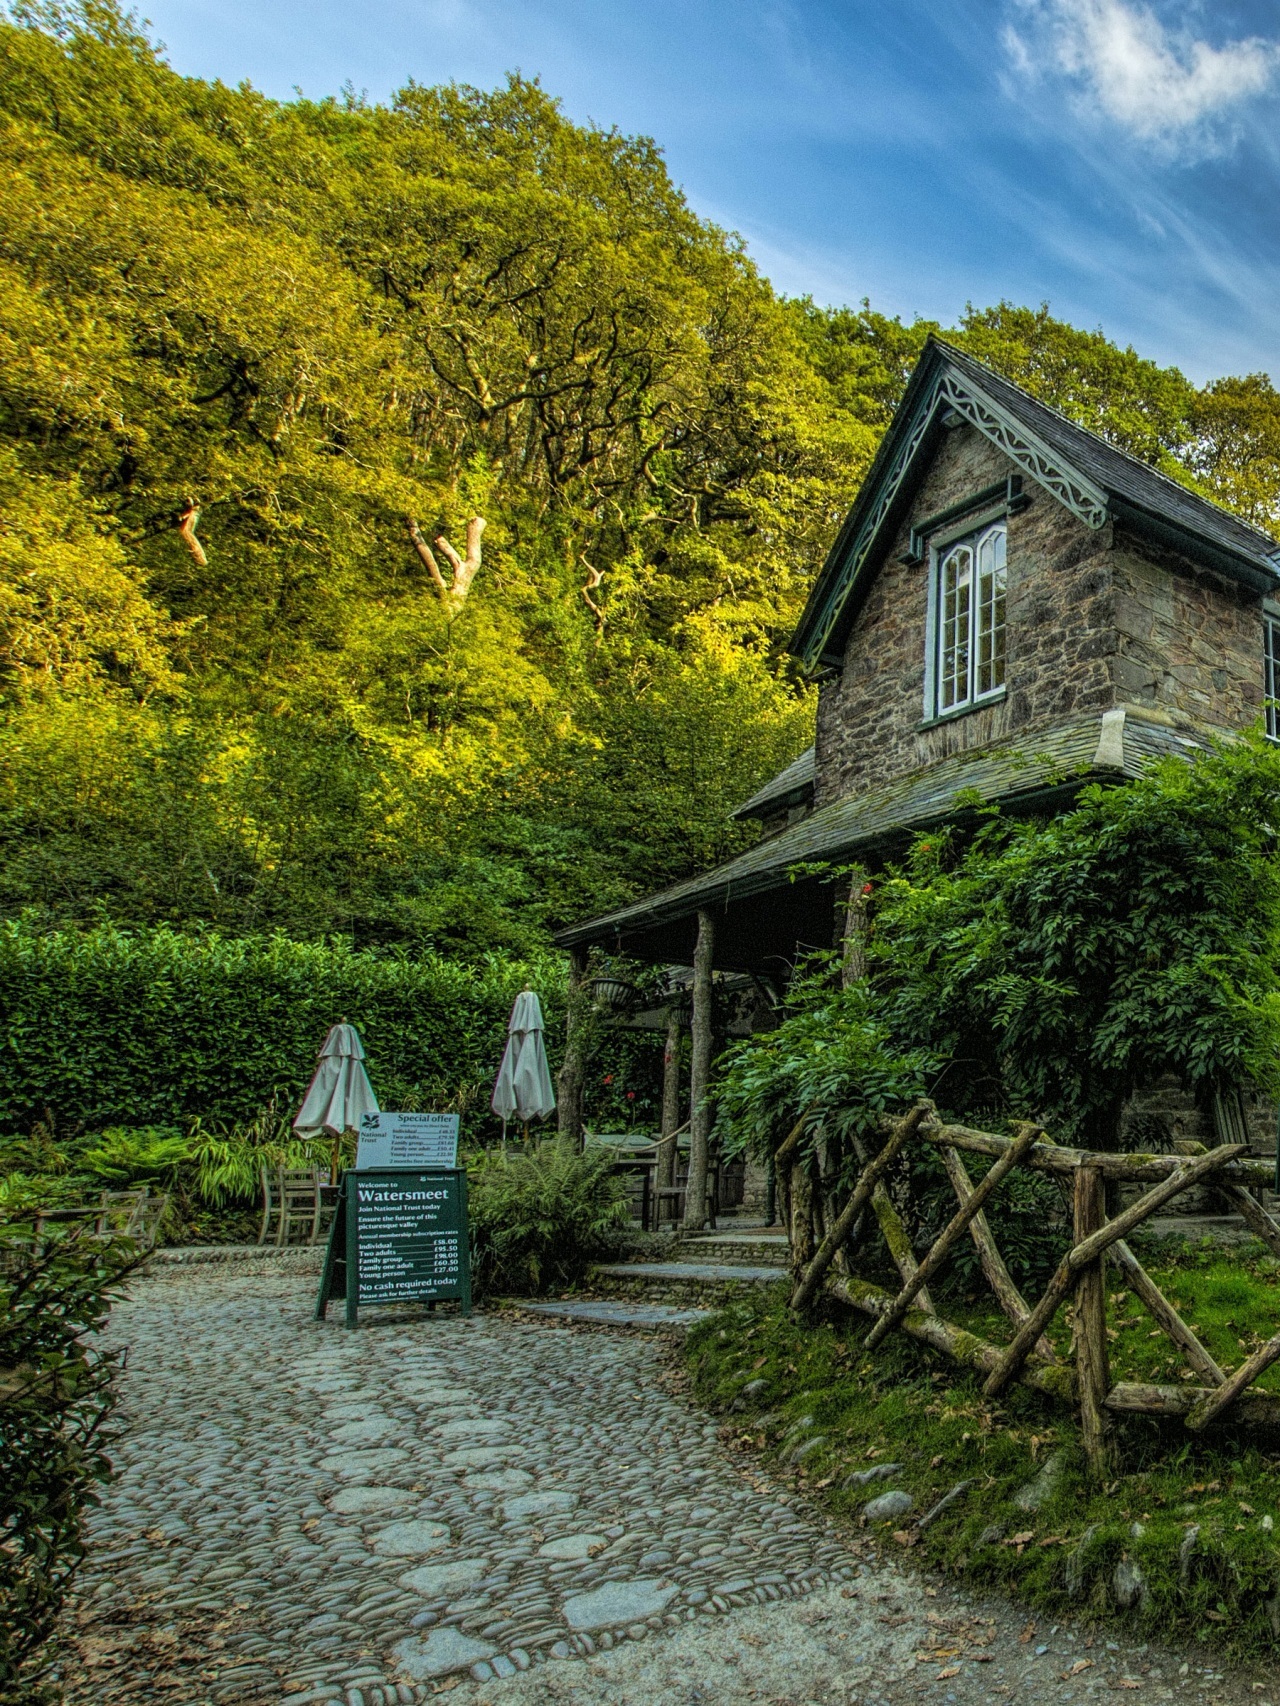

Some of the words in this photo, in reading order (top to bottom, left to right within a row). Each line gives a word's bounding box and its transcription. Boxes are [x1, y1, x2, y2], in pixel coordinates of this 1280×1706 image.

[398, 1114, 429, 1123] Special
[432, 1114, 453, 1123] offer
[358, 1189, 449, 1202] Watersmeet
[358, 1223, 398, 1231] picturesque
[374, 1281, 394, 1290] cash
[396, 1278, 432, 1289] required
[433, 1277, 458, 1285] today
